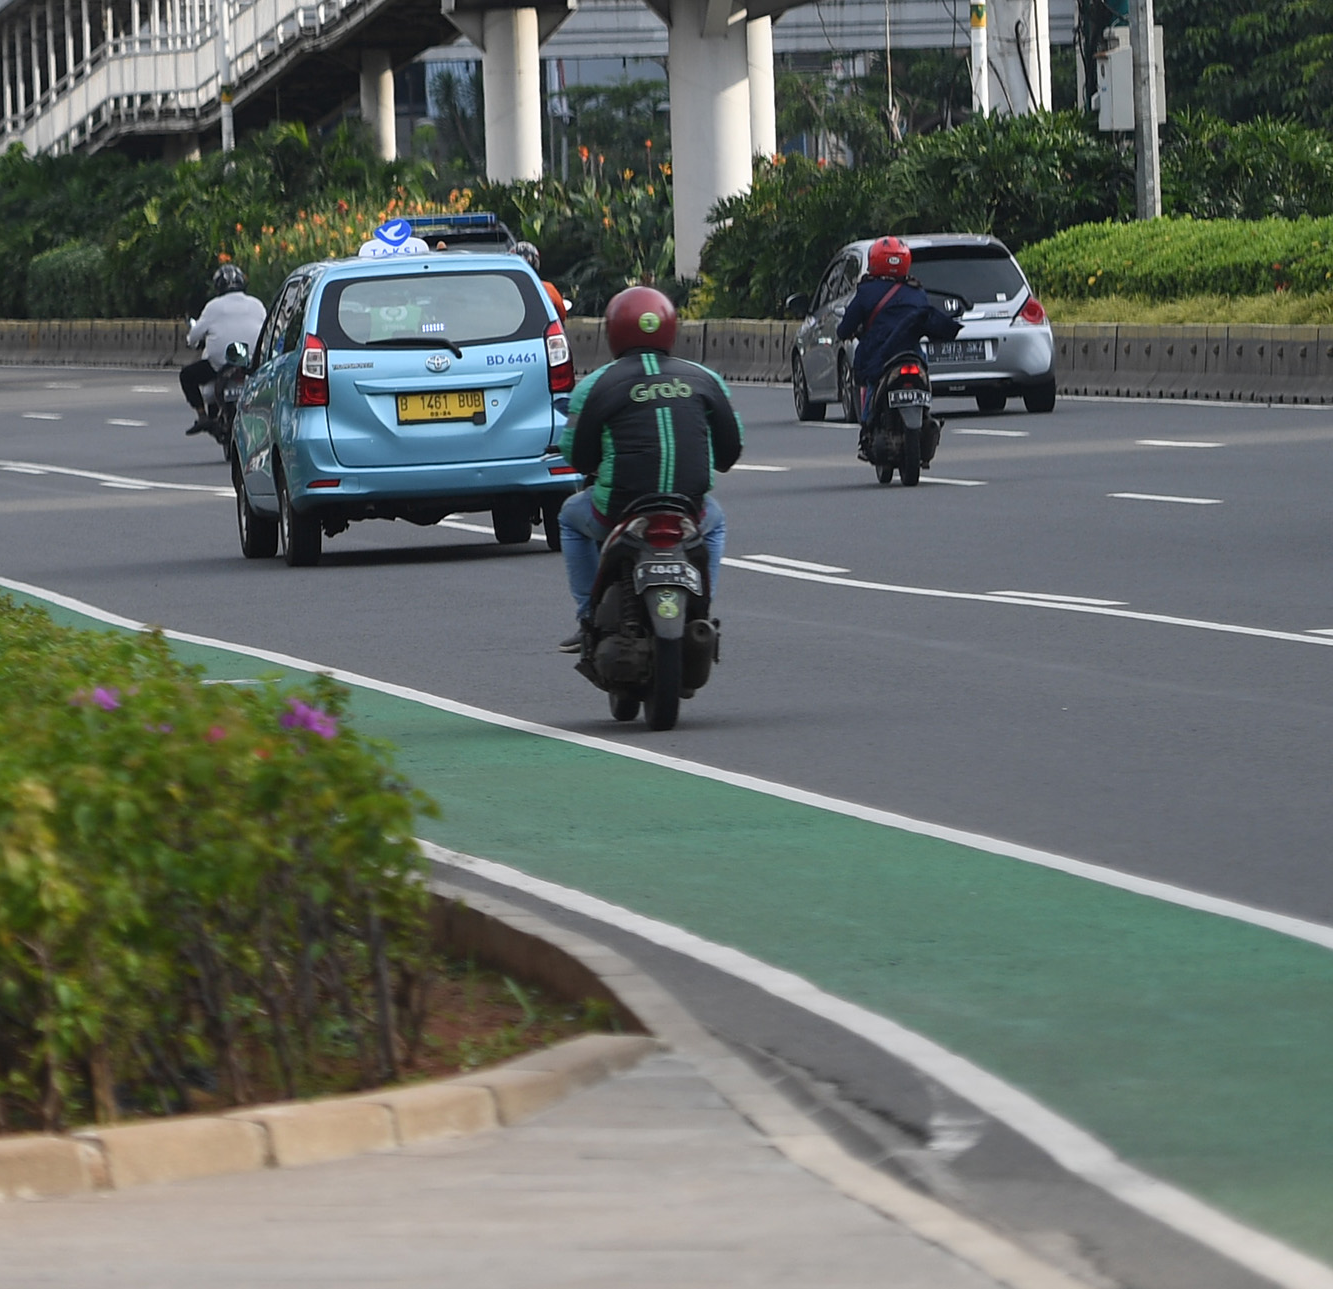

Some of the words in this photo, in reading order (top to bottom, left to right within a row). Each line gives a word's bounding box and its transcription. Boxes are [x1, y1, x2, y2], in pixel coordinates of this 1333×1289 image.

[486, 354, 505, 366] BD
[507, 352, 537, 364] 6461
[629, 377, 693, 403] Grab
[400, 396, 409, 411] B
[420, 394, 448, 410] 1461
[458, 393, 481, 408] BUB
